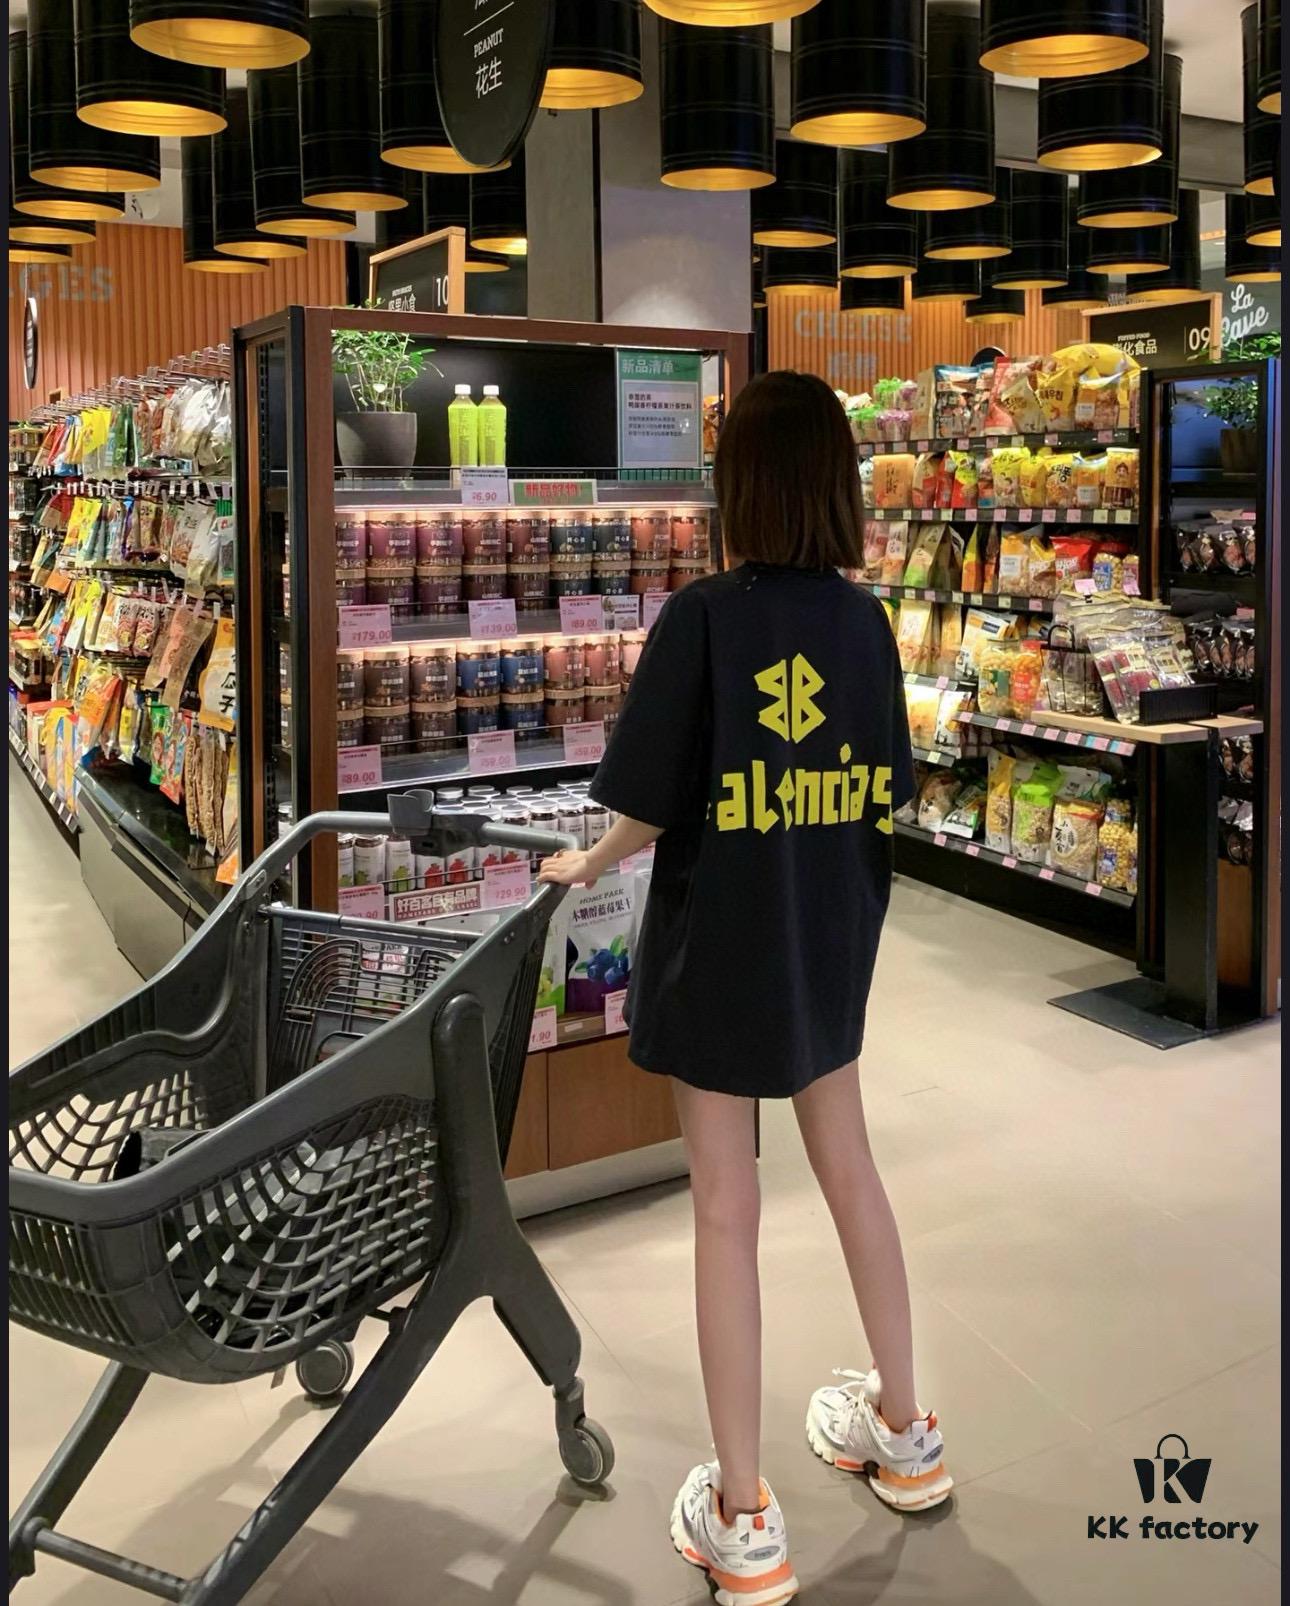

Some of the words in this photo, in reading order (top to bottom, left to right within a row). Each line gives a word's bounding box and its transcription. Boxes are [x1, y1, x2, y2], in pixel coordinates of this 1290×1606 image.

[473, 28, 504, 58] PEANUT
[475, 56, 503, 99] 花生
[436, 275, 449, 307] 10
[1231, 283, 1255, 314] La
[1189, 327, 1211, 351] 09
